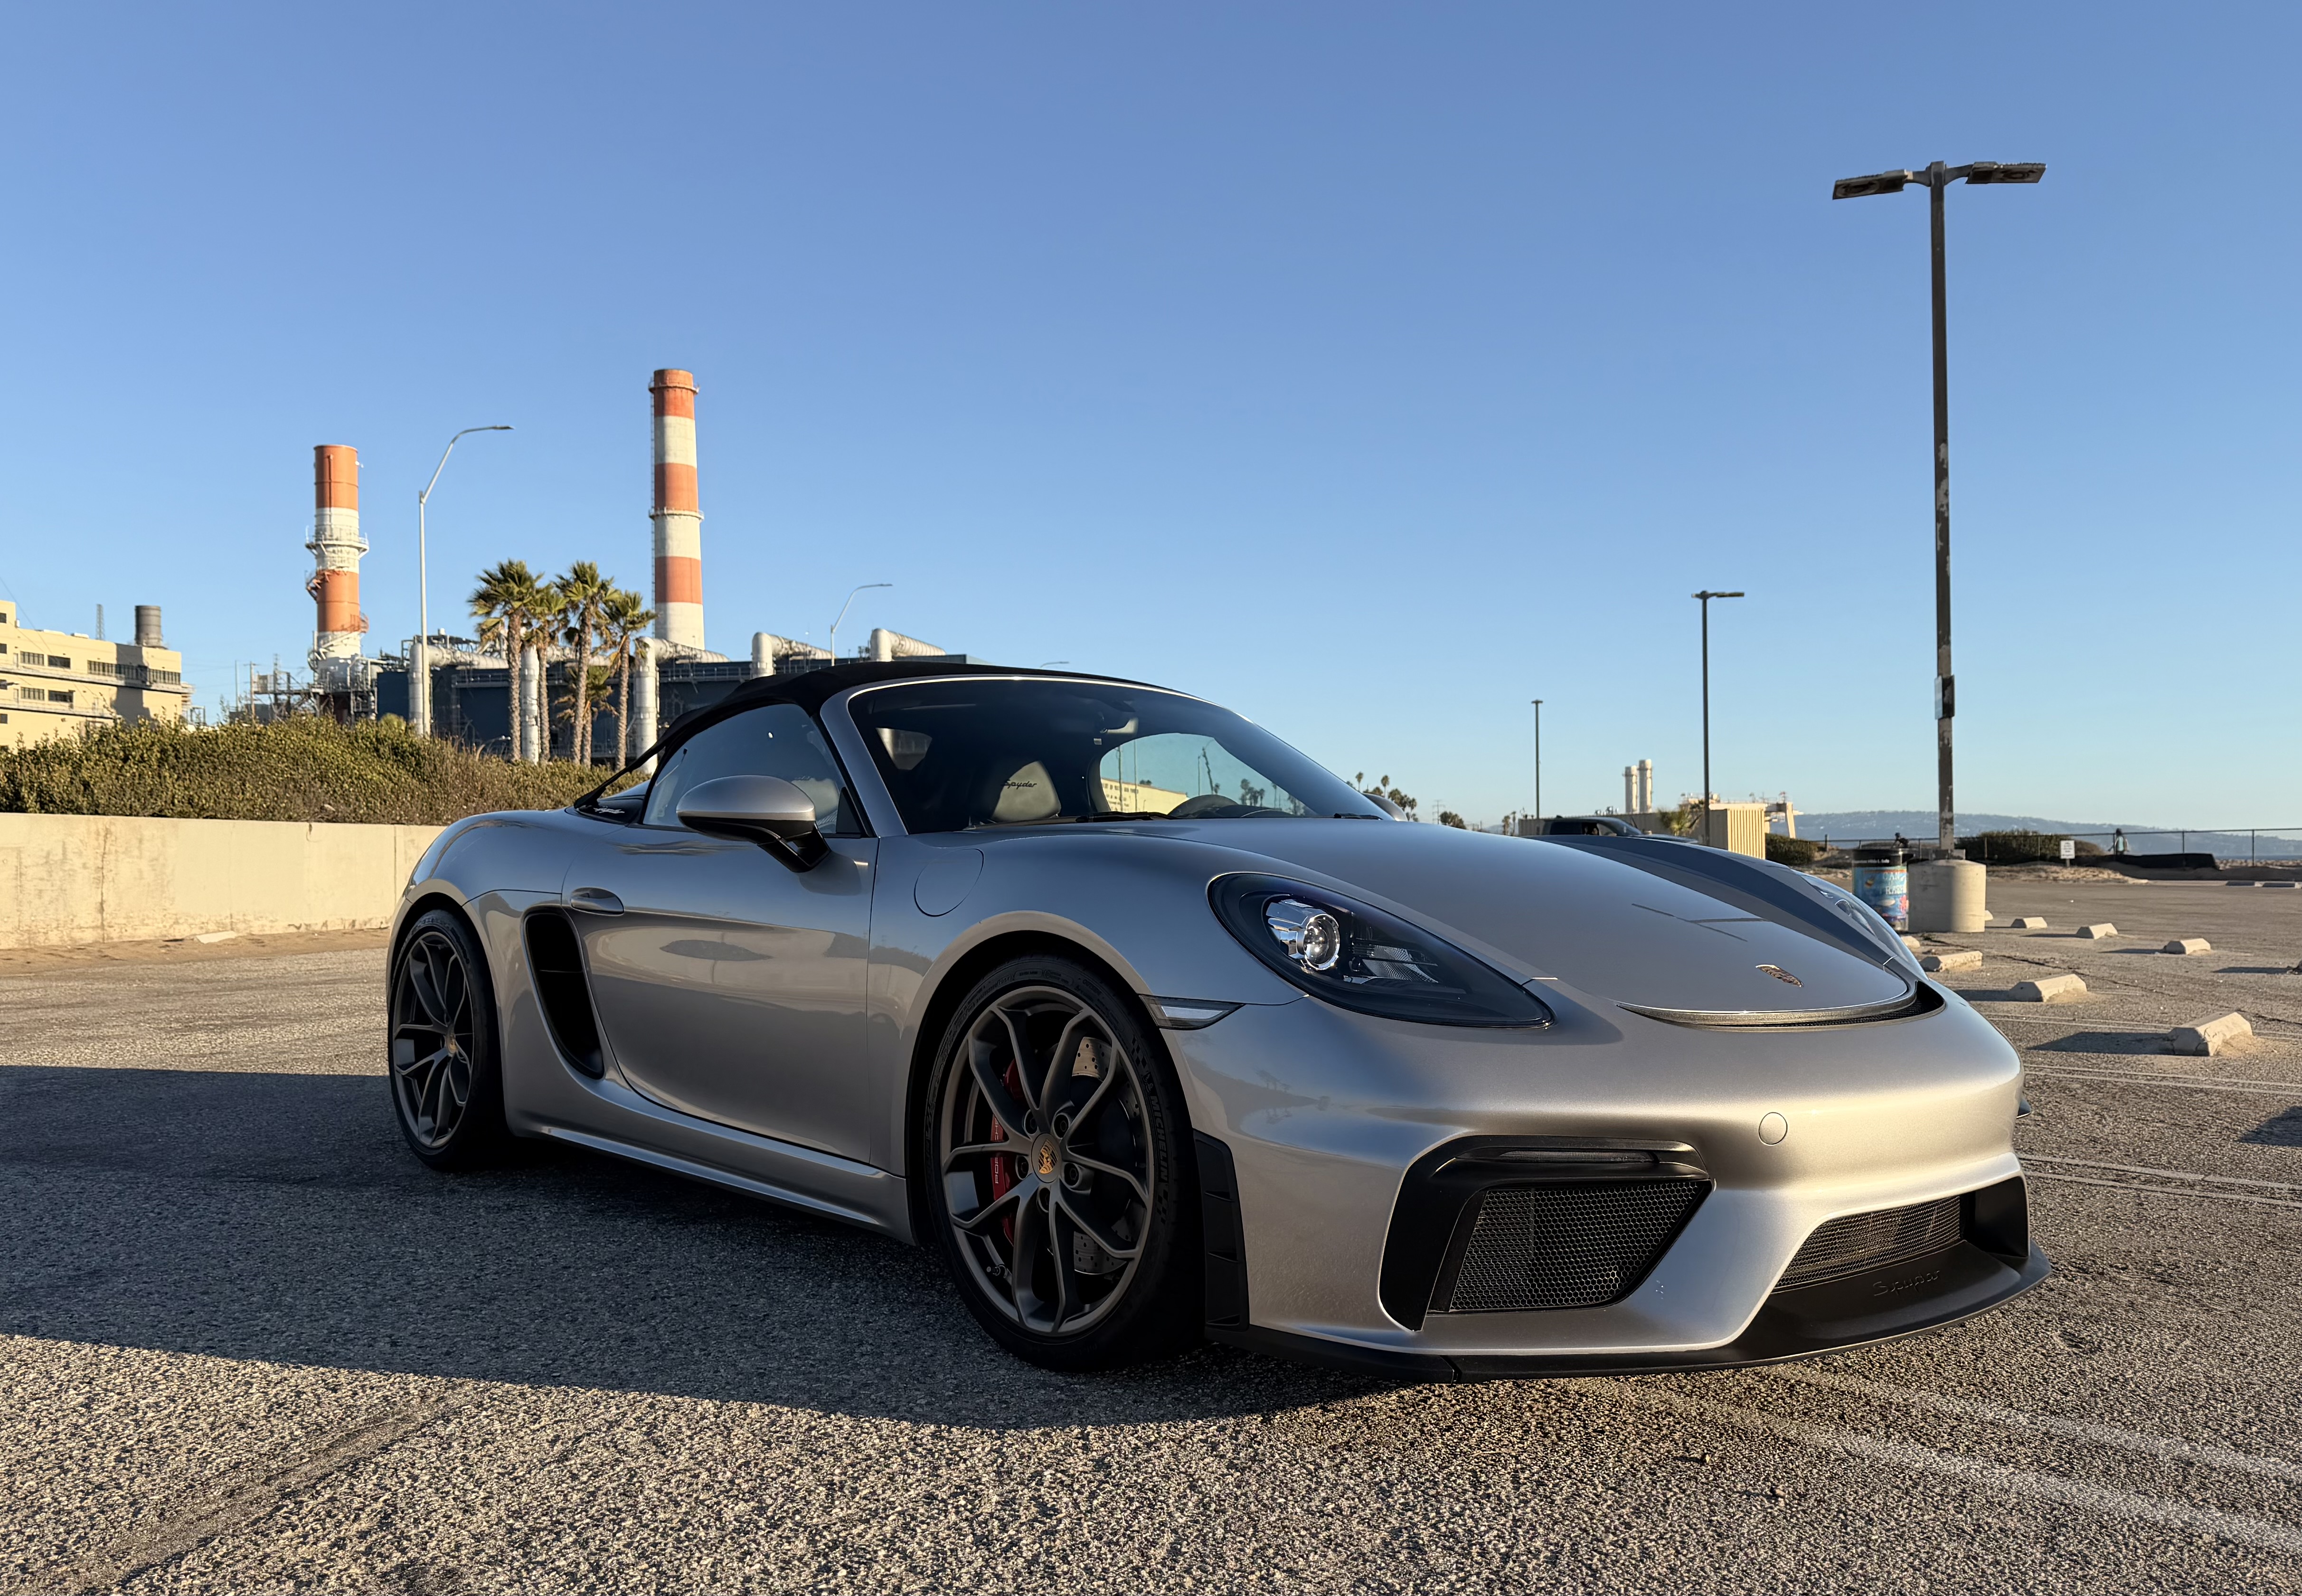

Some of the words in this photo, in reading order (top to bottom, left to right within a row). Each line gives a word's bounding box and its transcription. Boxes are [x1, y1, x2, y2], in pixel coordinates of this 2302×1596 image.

[1000, 779, 1037, 789] Spyder
[1151, 1095, 1169, 1183] MICHELIN
[1873, 1270, 1940, 1296] Spyder
